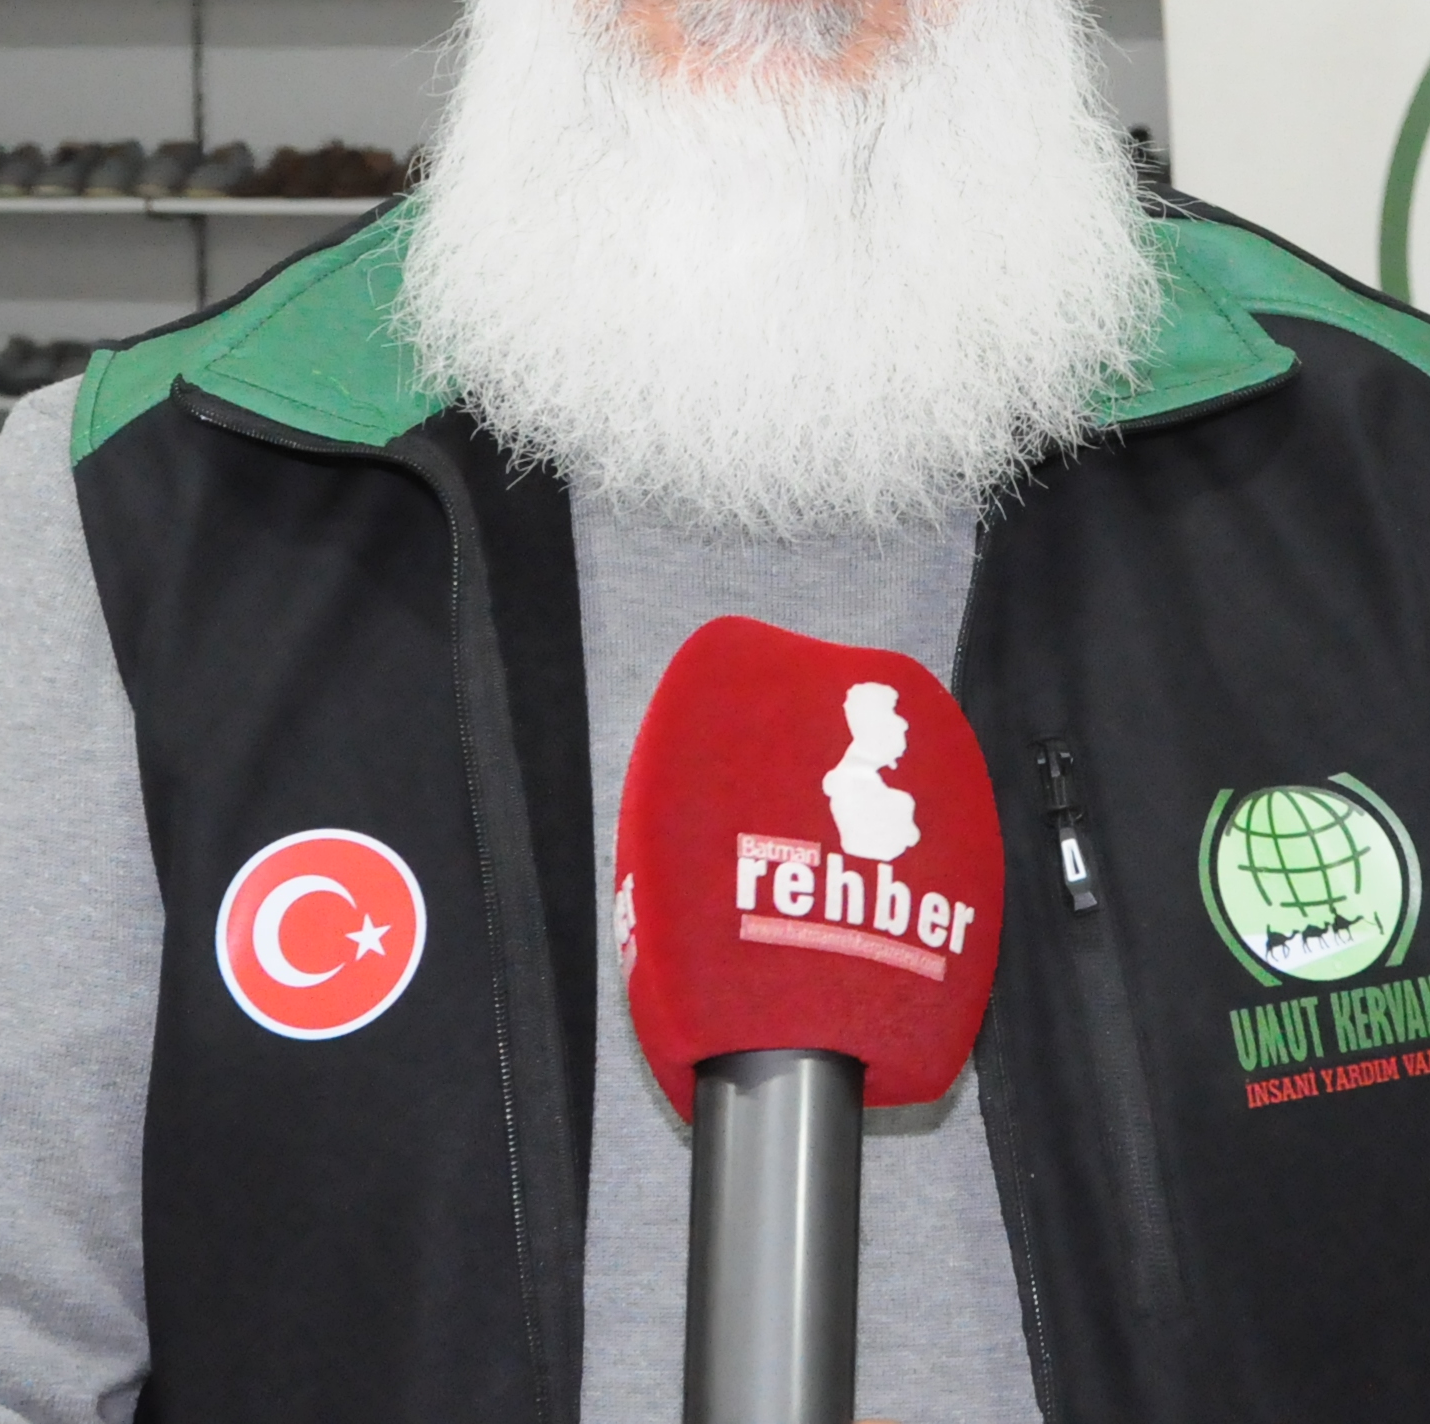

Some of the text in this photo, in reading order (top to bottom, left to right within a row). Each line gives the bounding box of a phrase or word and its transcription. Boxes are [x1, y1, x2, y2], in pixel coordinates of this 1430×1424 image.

[740, 835, 819, 866] Batman
[736, 852, 975, 955] rehber
[1230, 996, 1324, 1072] UMUT
[1245, 1066, 1319, 1109] İNSANİ
[1320, 1056, 1400, 1093] YARDIM
